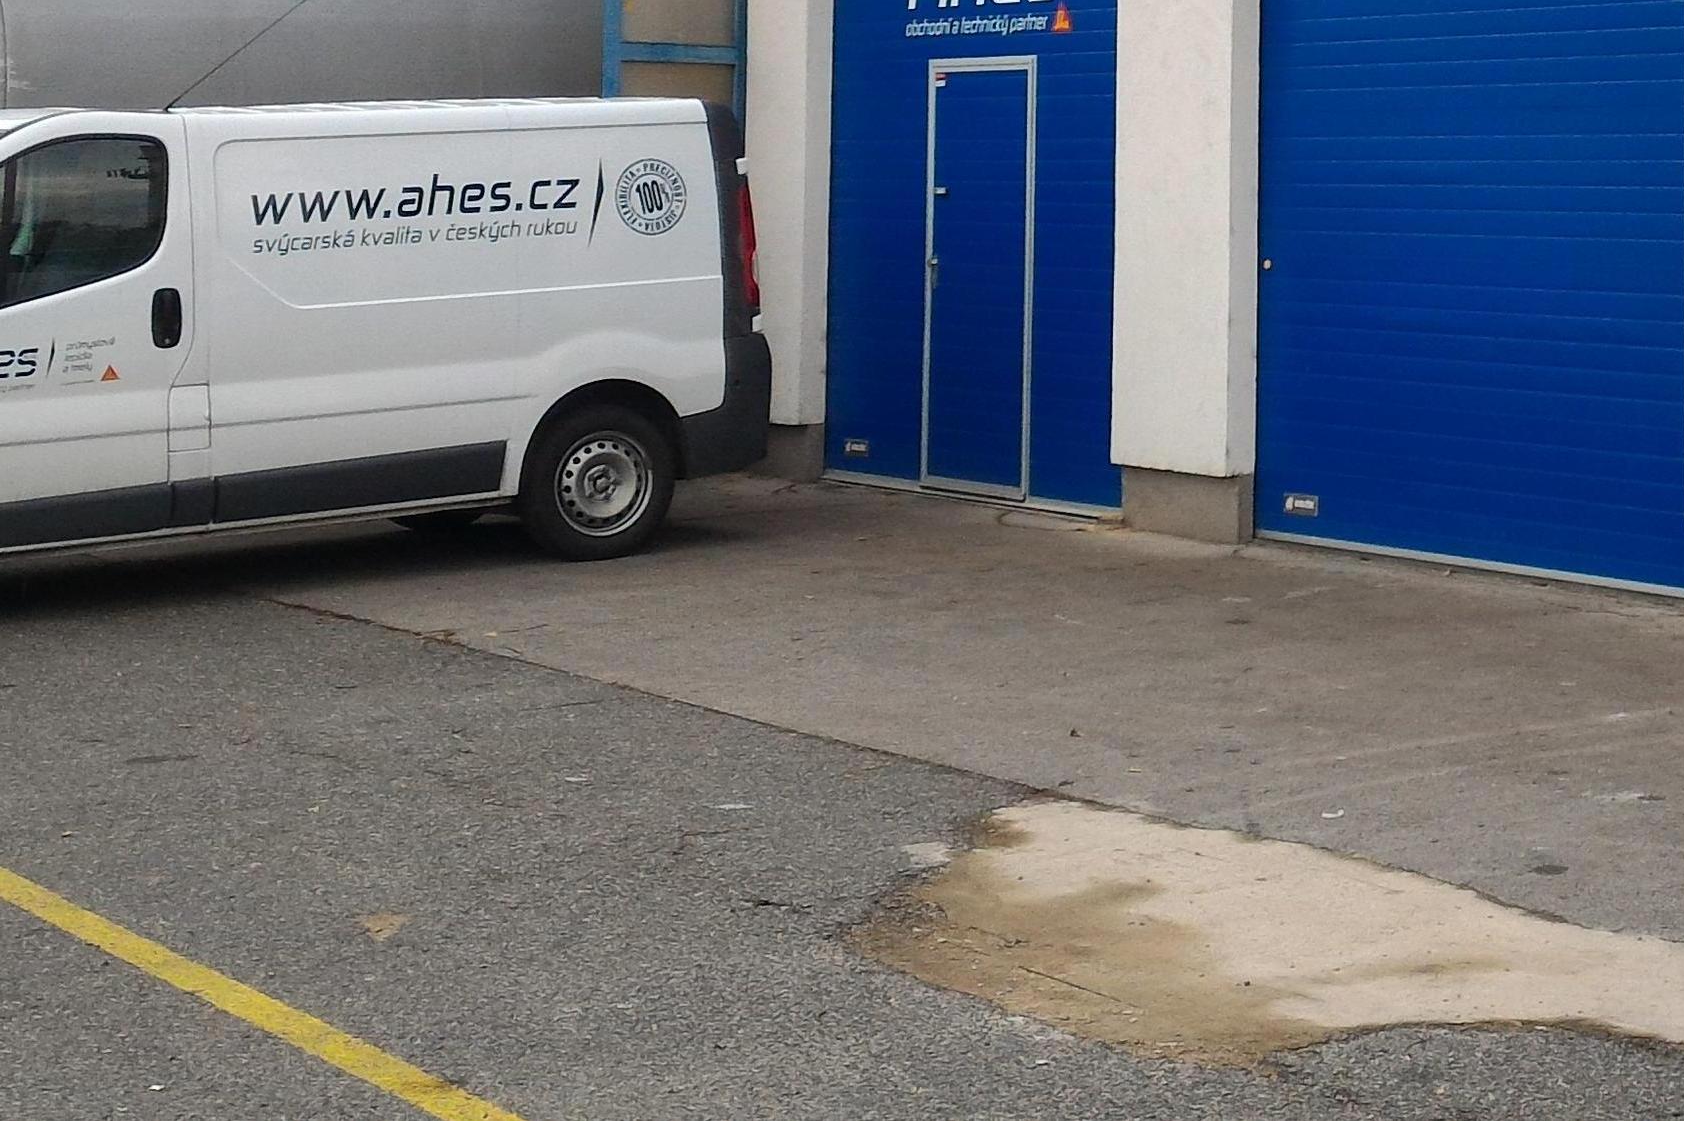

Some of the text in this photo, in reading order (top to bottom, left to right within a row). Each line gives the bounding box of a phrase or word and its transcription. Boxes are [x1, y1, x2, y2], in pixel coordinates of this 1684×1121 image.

[952, 20, 959, 34] a
[251, 174, 580, 226] www.ahes.cz
[635, 180, 664, 215] 100
[360, 227, 421, 247] kvalita
[429, 230, 441, 242] v
[446, 218, 521, 243] českých
[526, 219, 578, 237] rukou
